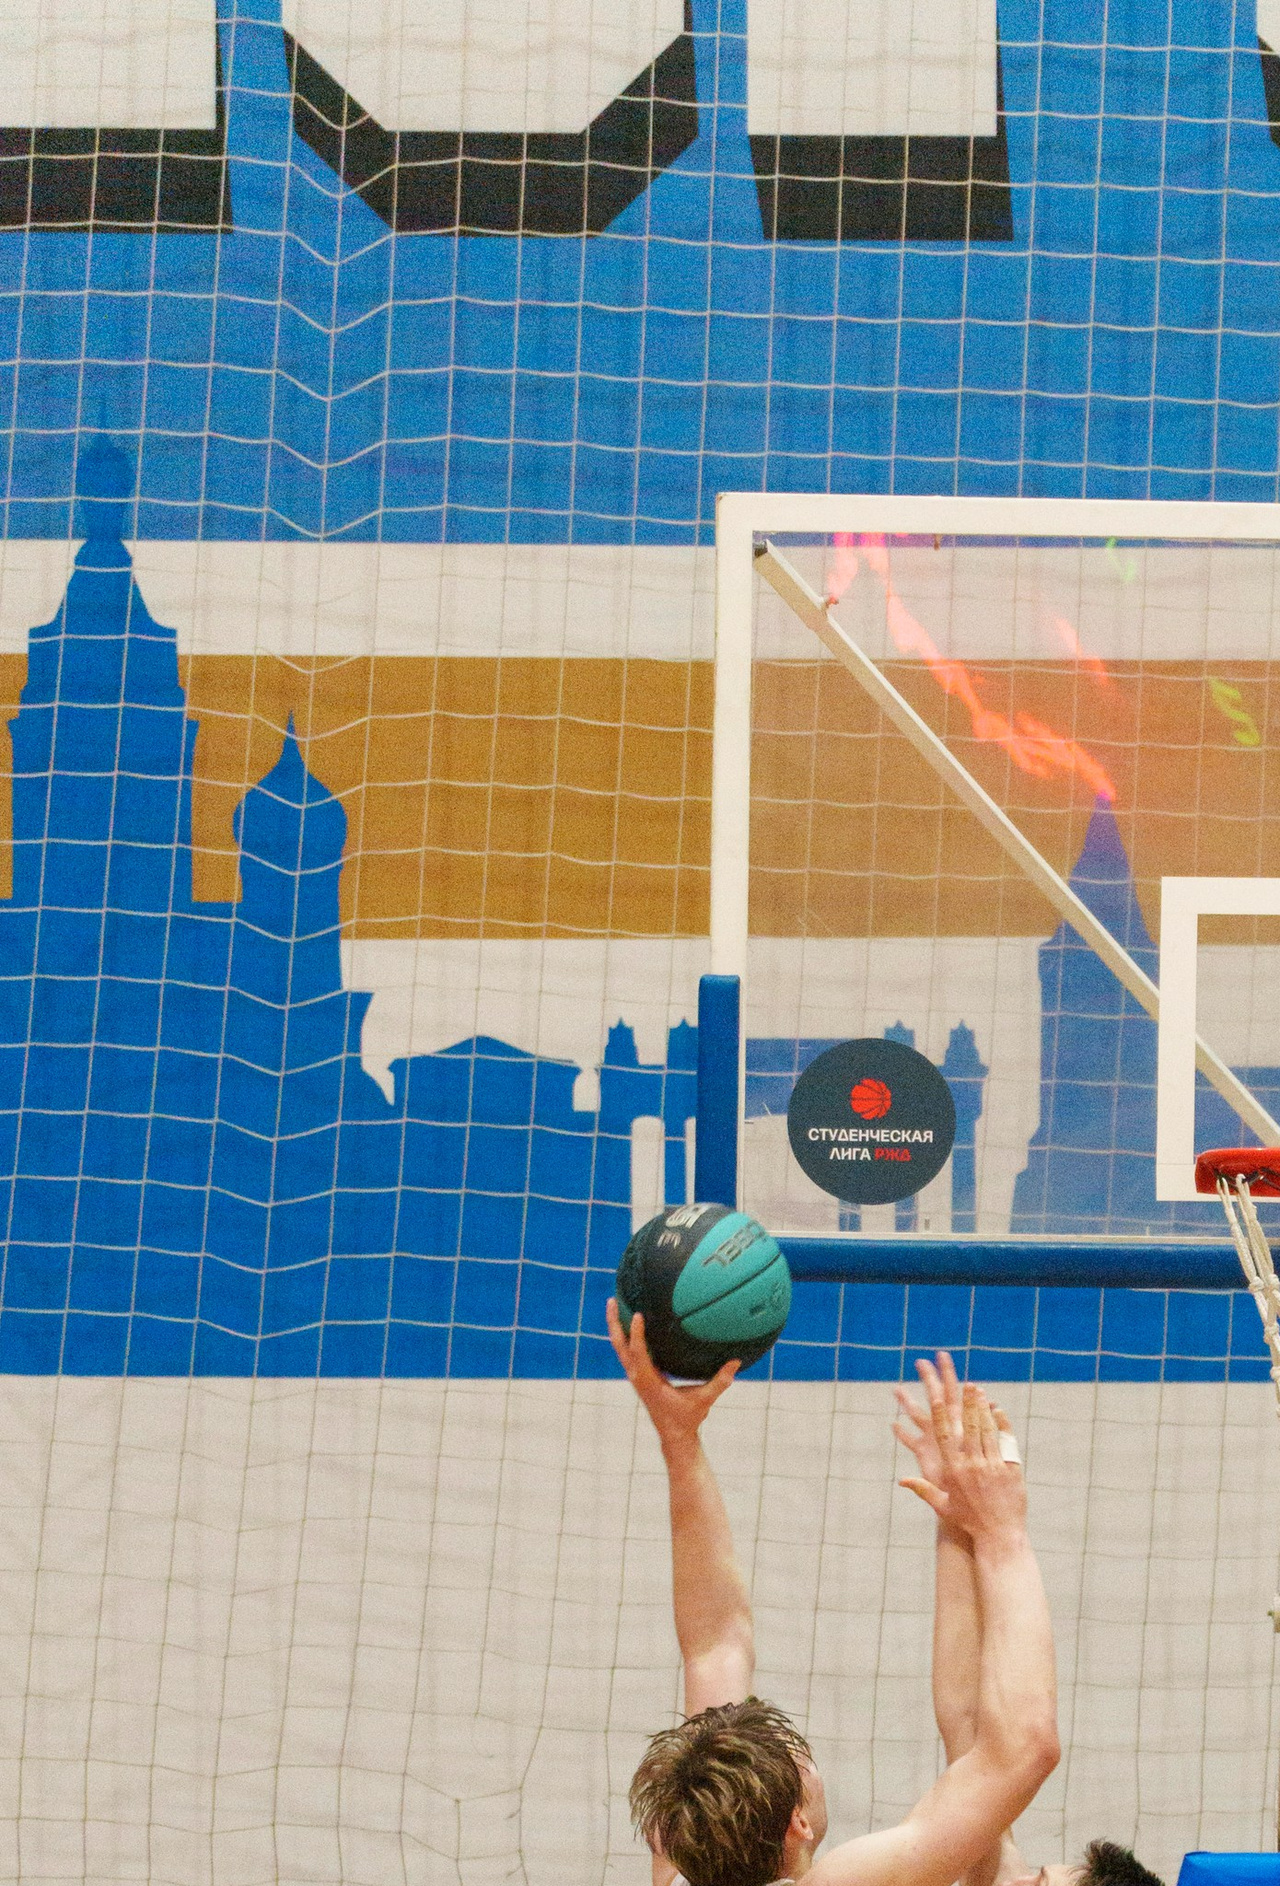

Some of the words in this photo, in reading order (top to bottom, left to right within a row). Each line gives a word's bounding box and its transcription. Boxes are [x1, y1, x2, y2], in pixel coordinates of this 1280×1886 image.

[808, 1127, 933, 1143] СТУДЕНЧЕСКАЯ
[829, 1147, 871, 1161] ЛИГА
[874, 1147, 912, 1162] РЖД
